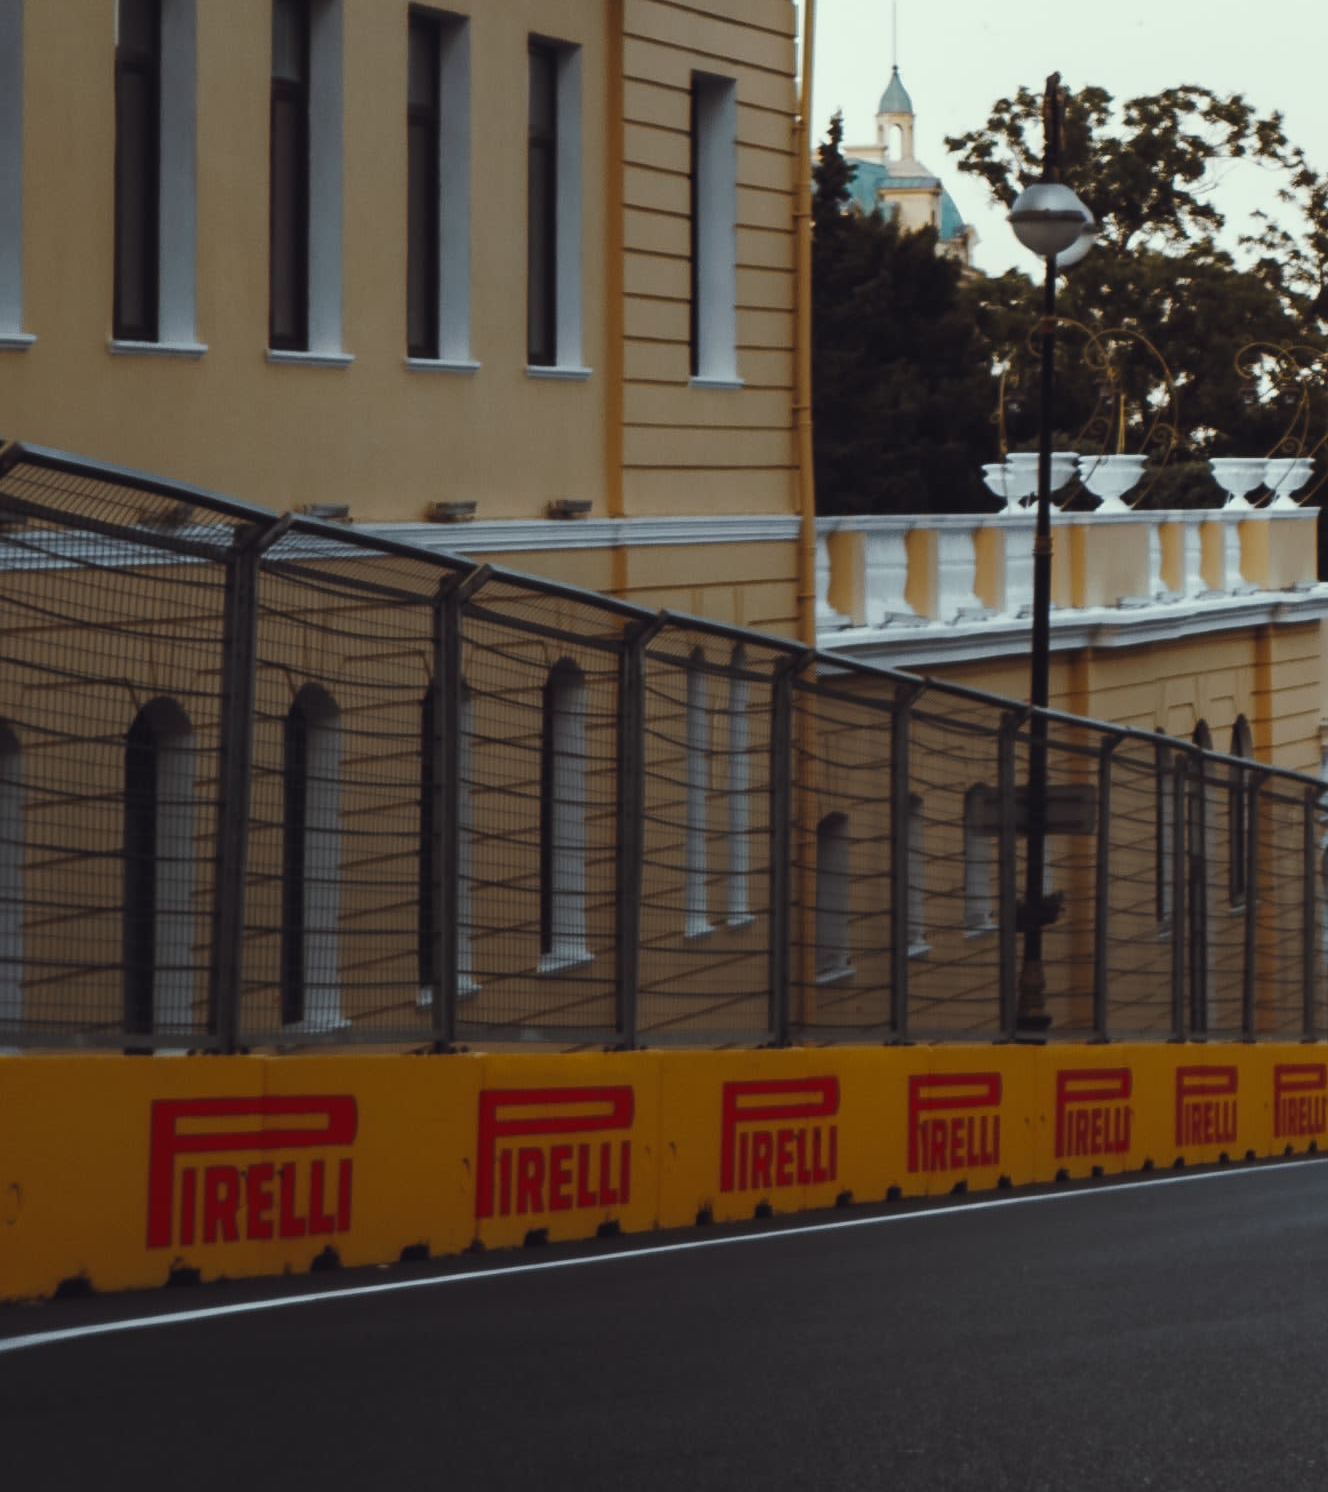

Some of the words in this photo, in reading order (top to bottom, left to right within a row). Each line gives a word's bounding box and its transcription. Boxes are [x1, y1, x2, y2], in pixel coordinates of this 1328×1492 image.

[475, 1085, 635, 1218] PIRELLI
[720, 1075, 840, 1193] PIRELLI
[907, 1072, 1002, 1173] PIRELLI
[1055, 1068, 1132, 1158] PIRELLI
[1175, 1066, 1238, 1148] PIRELLI
[1274, 1064, 1328, 1138] PIRELLI
[147, 1095, 358, 1250] PIRELLI
